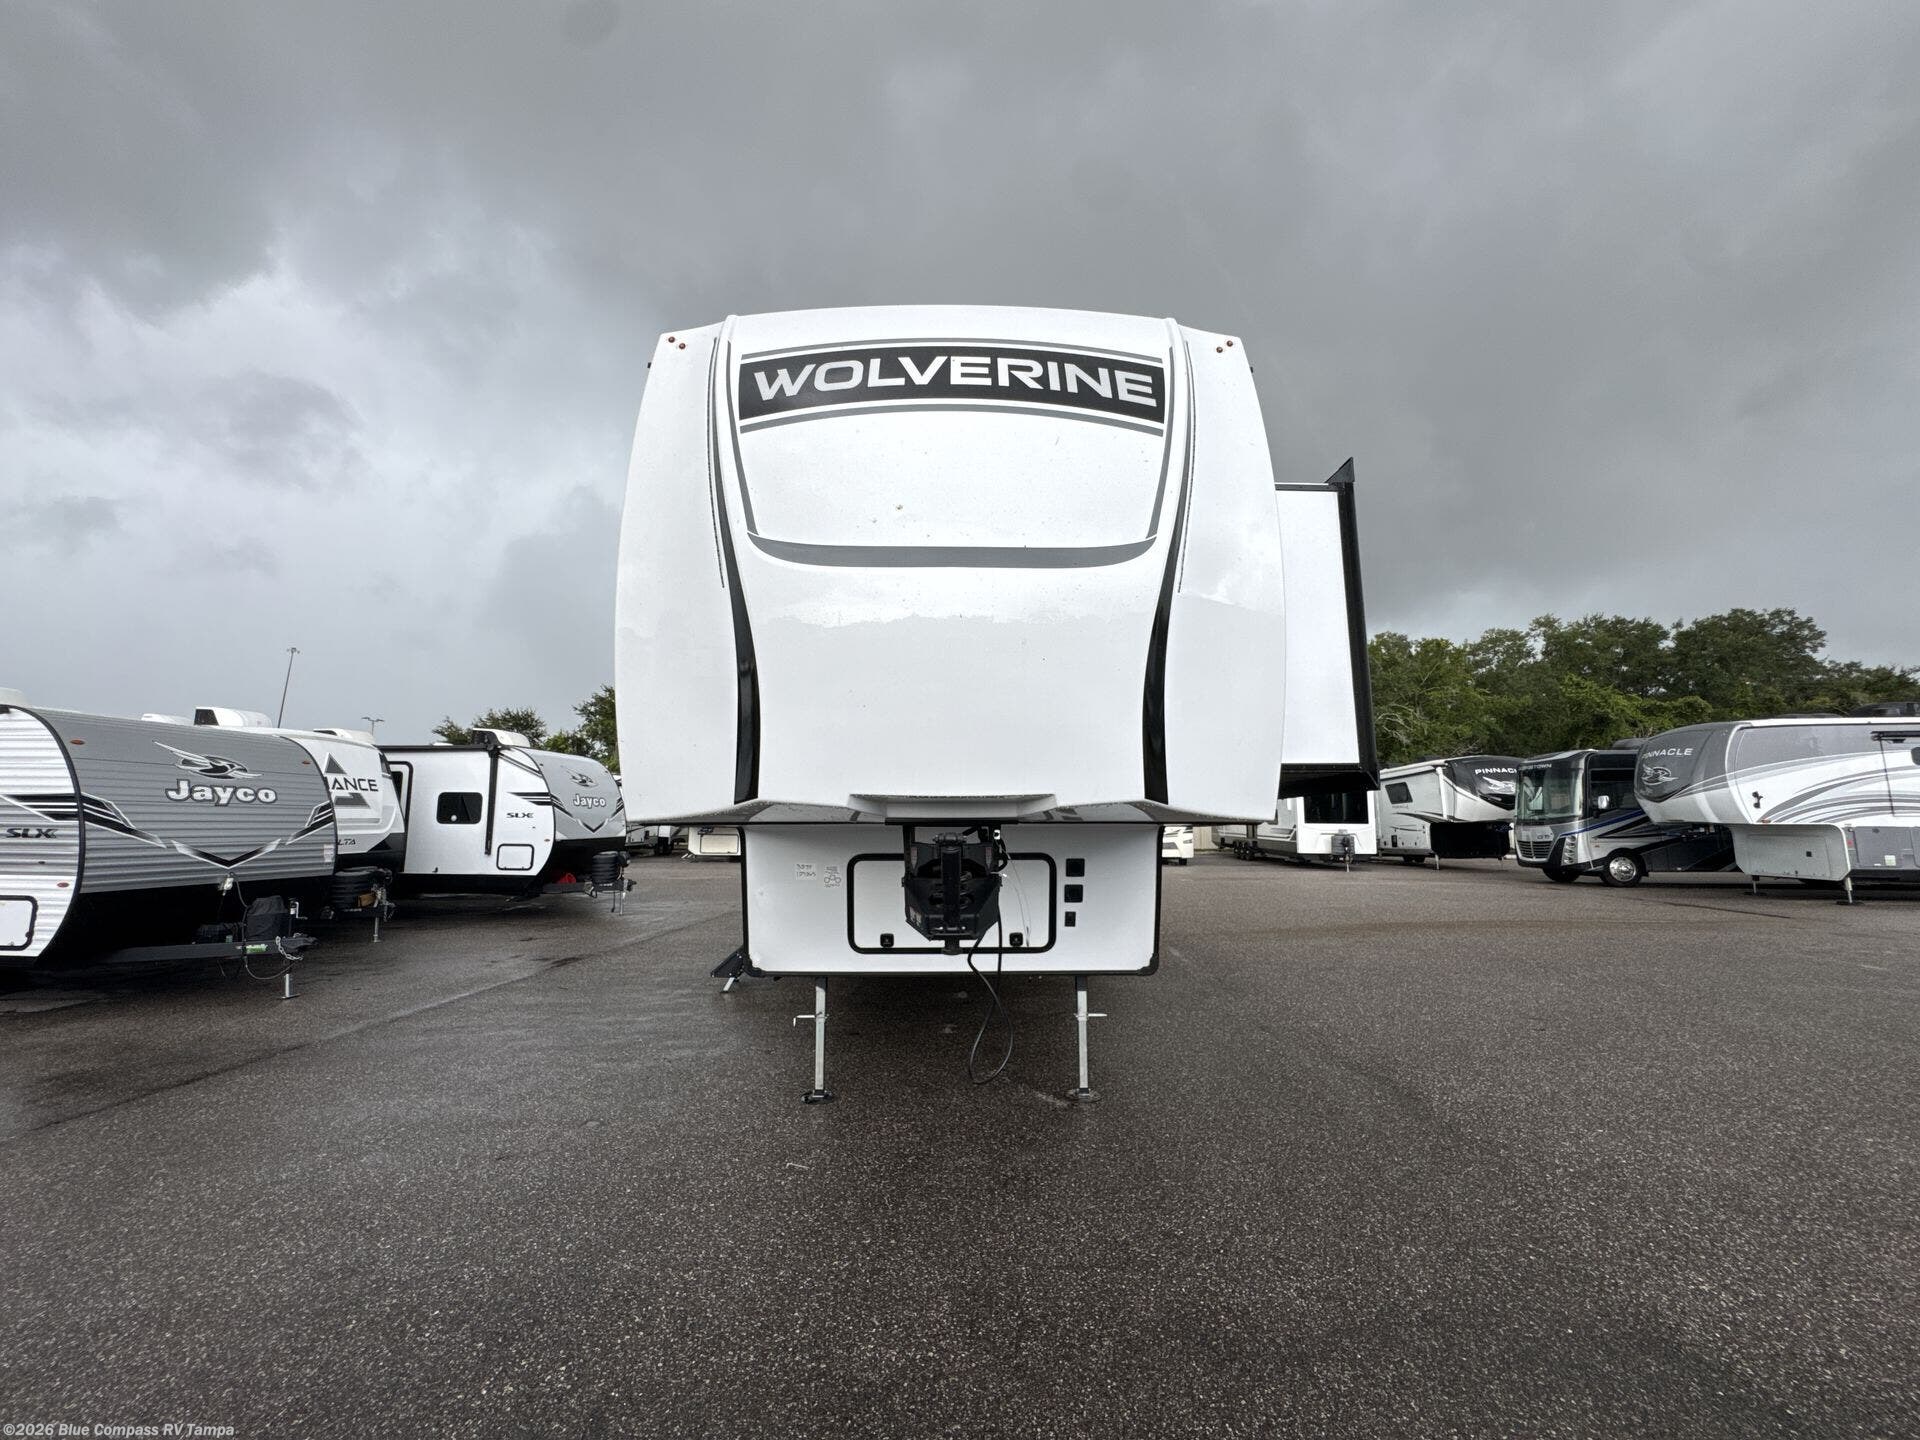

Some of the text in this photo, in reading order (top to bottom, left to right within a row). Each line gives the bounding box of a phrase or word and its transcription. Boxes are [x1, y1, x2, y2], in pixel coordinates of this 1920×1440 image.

[754, 355, 1158, 407] WOLVERINE
[165, 778, 278, 807] Jayco
[573, 793, 607, 809] Jayco
[6, 827, 58, 839] SLX
